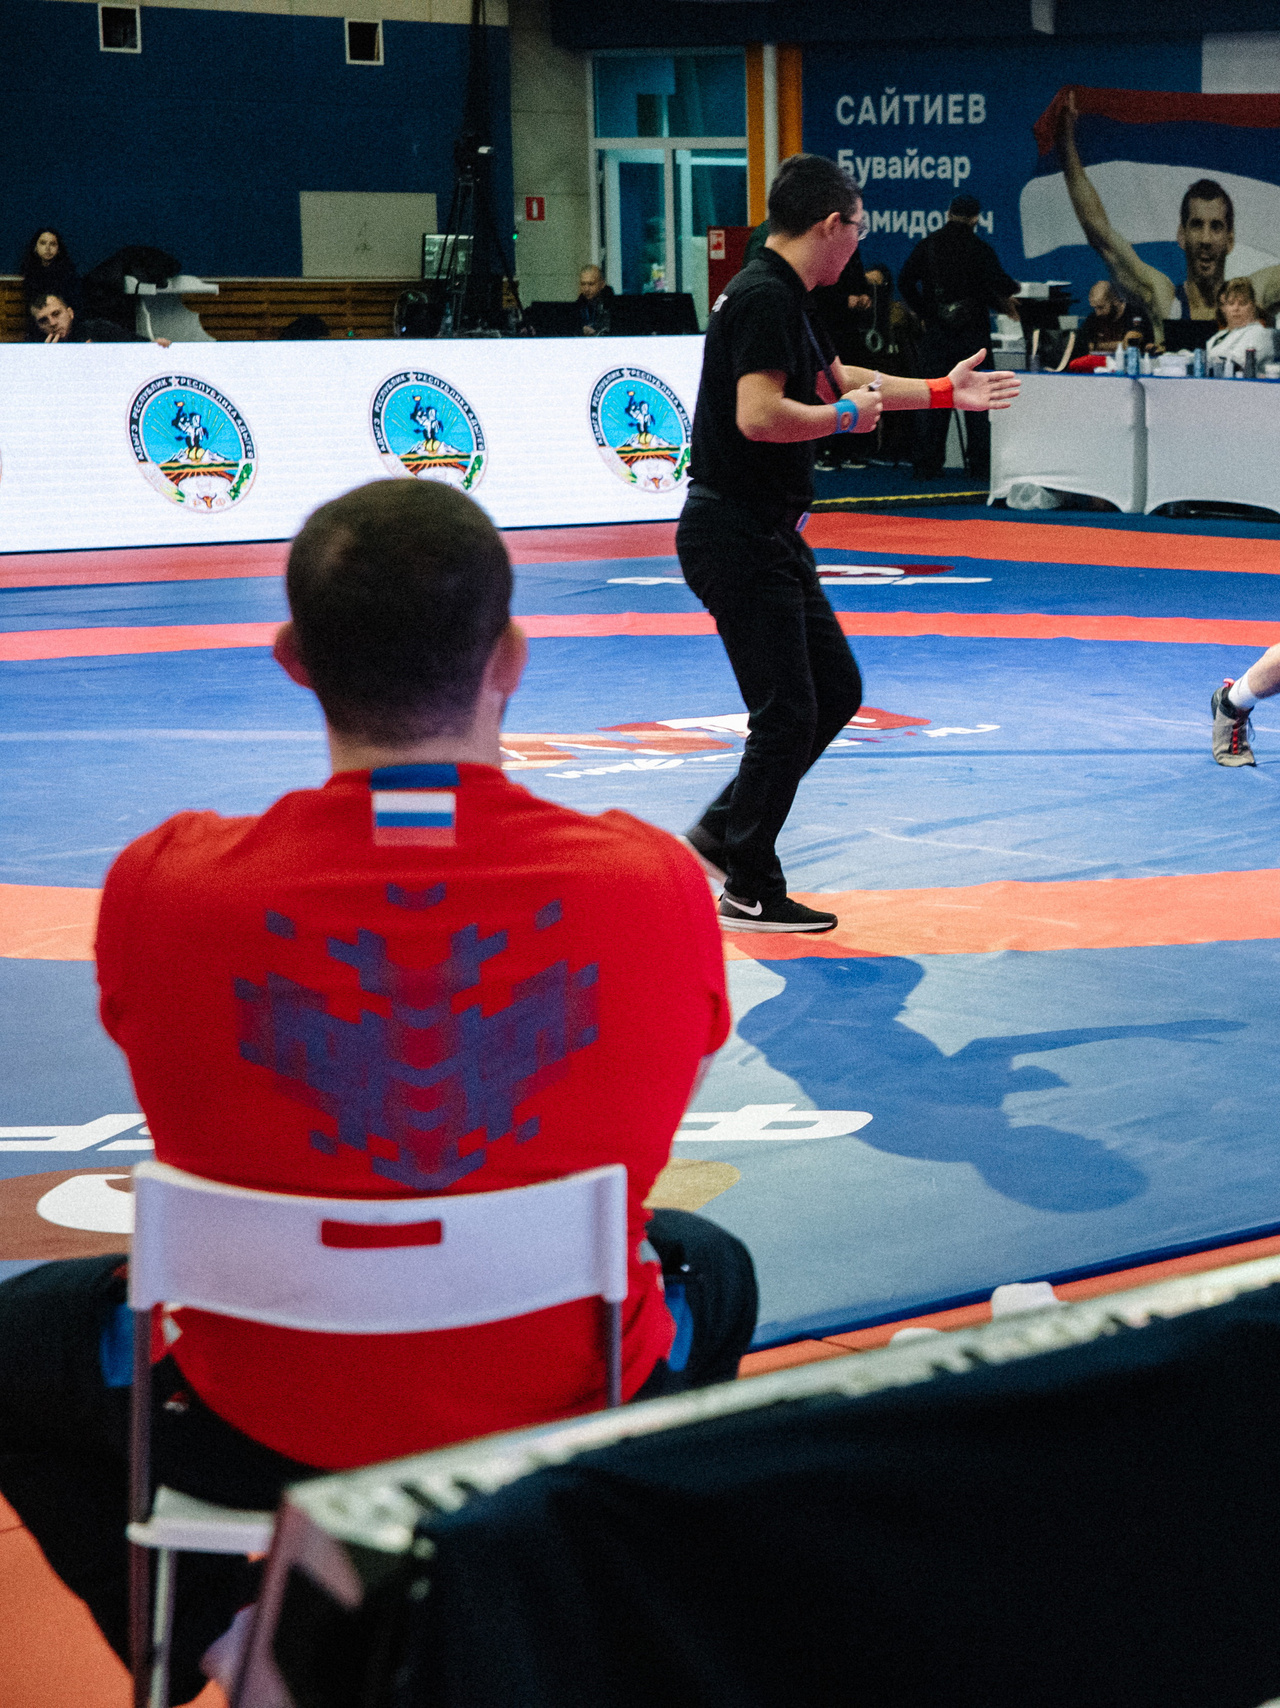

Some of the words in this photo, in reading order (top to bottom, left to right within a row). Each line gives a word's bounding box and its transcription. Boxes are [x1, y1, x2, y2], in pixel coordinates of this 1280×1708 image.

[836, 86, 987, 126] САЙТИЕВ
[837, 148, 971, 188] Бувайсар
[178, 378, 237, 421] РЕСПУБЛИКА
